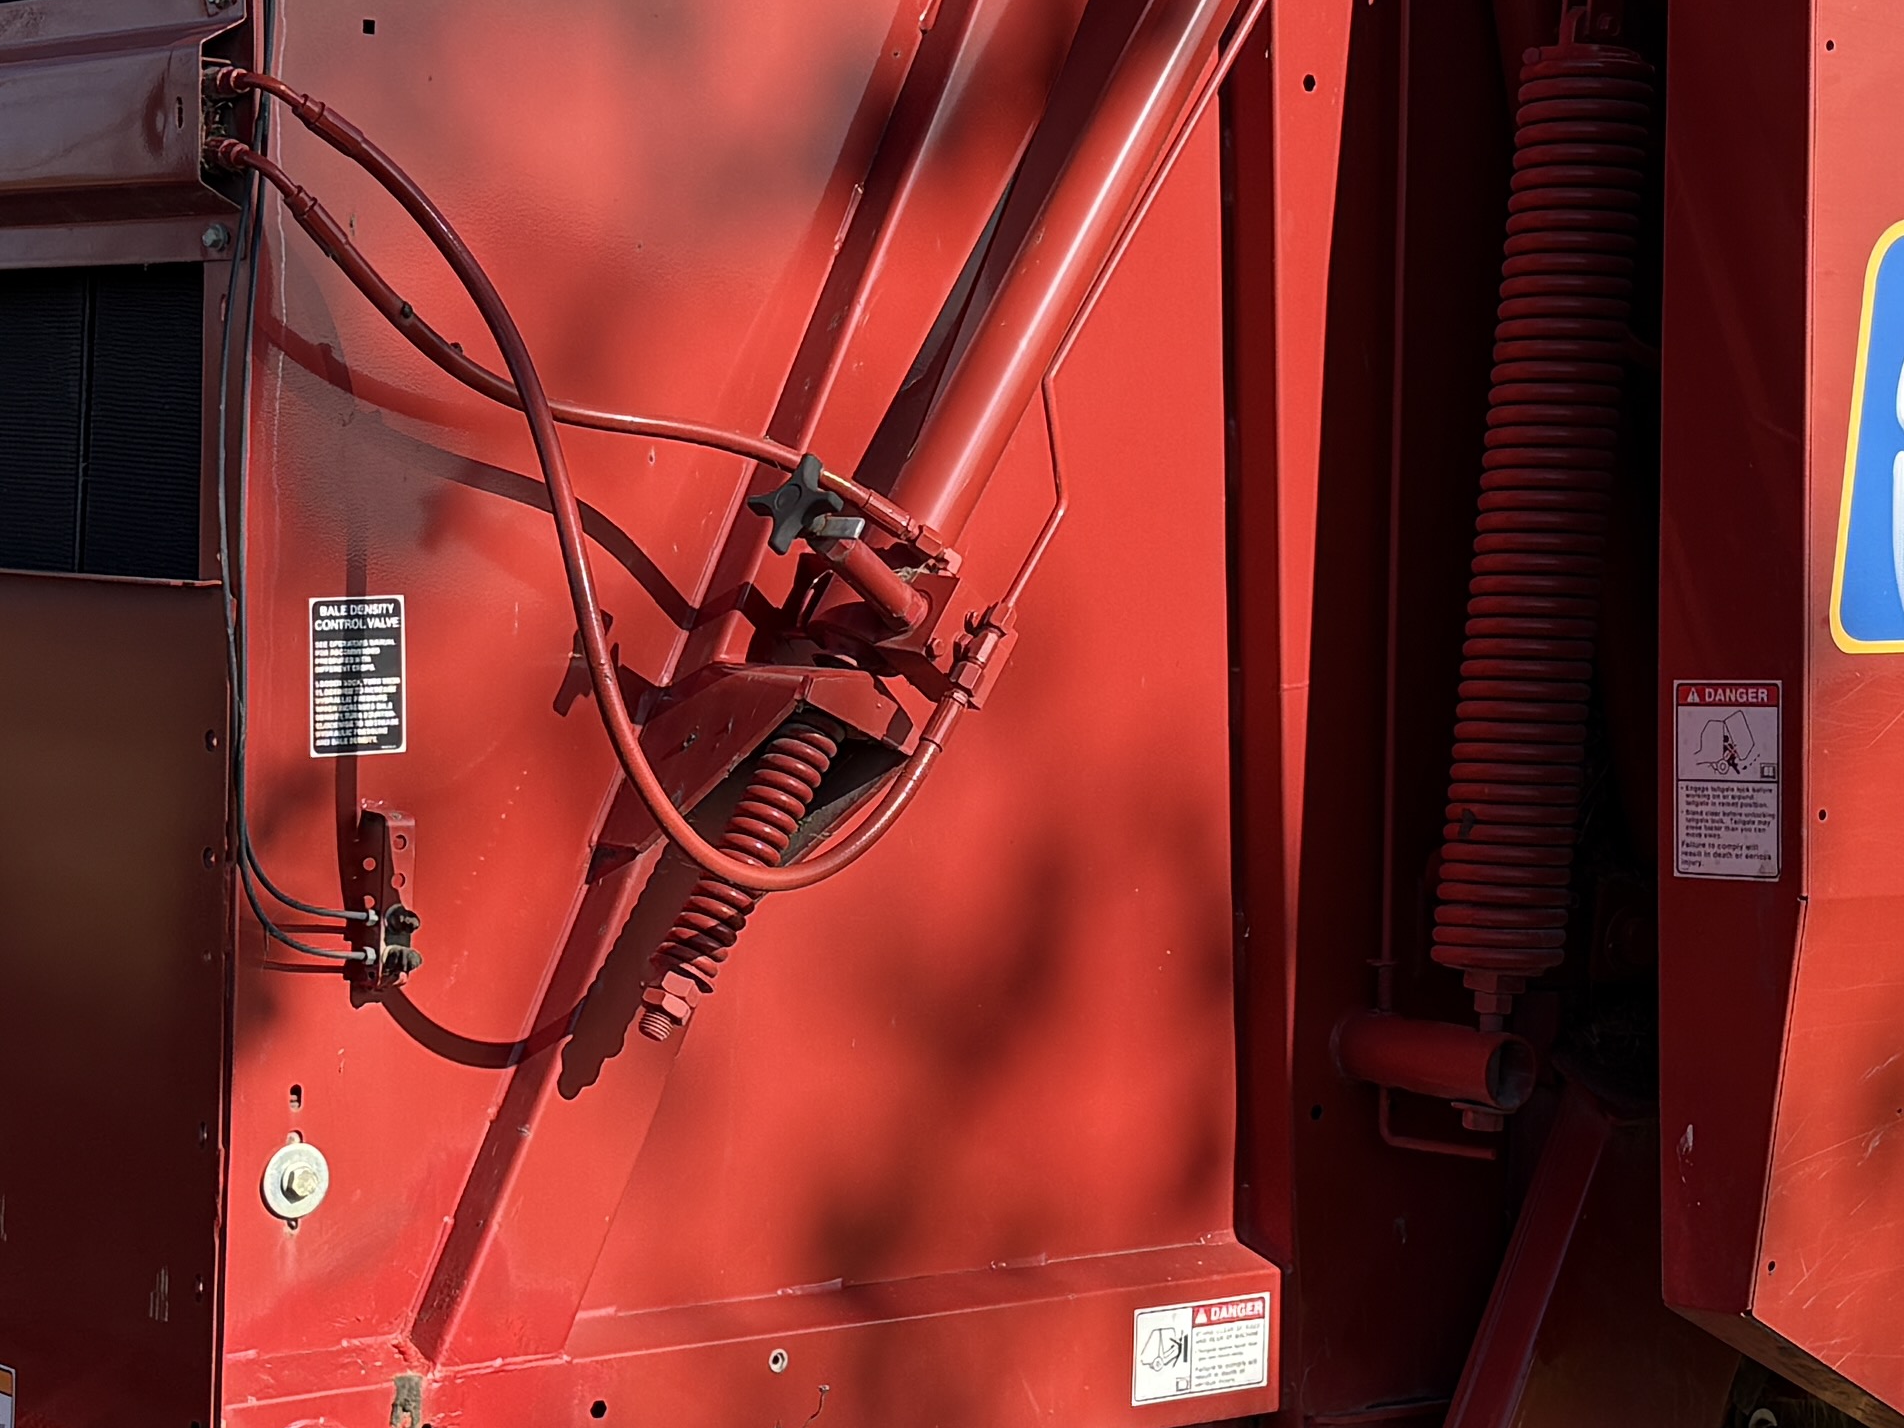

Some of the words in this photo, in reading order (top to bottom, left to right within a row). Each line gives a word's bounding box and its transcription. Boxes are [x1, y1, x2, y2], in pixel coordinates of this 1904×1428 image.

[319, 604, 347, 616] BALE
[350, 603, 395, 615] DENSITY
[314, 618, 366, 630] CONTROL
[367, 617, 400, 629] VALVE
[1705, 688, 1768, 703] DANGER
[1211, 1301, 1264, 1321] DANGER
